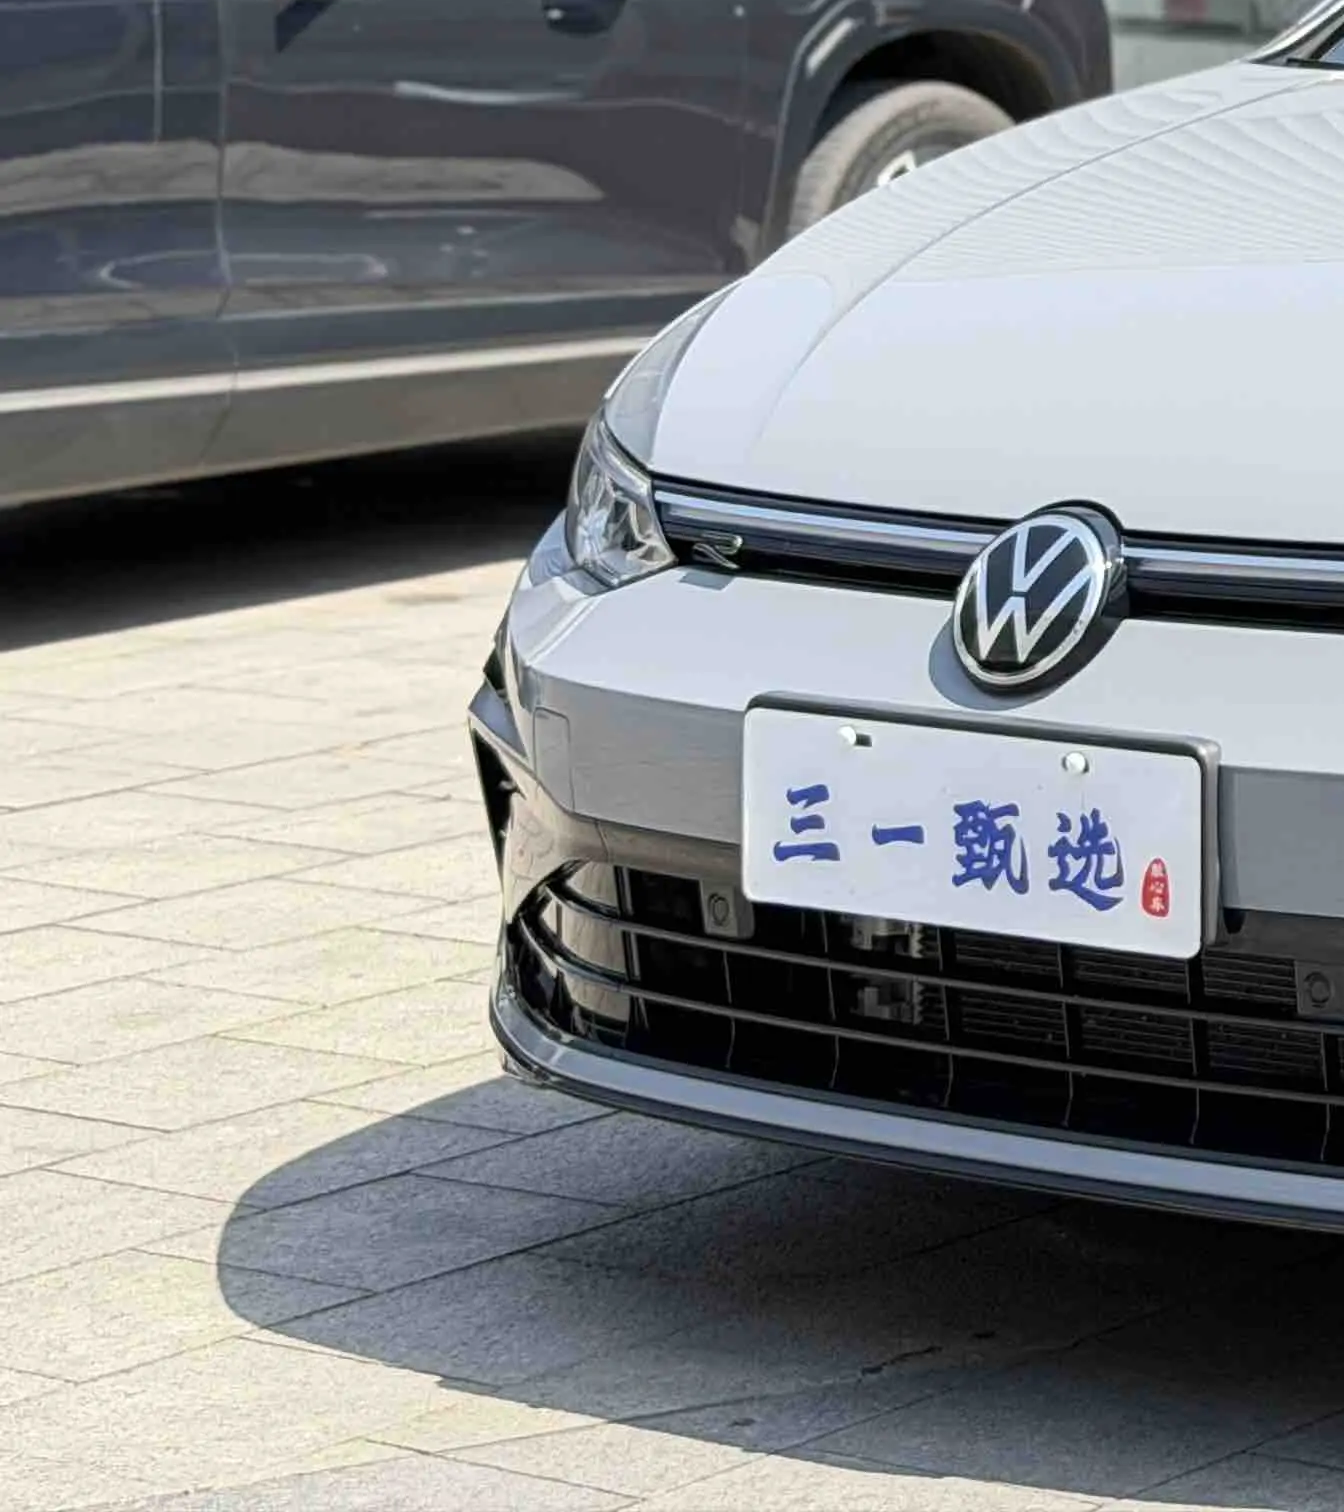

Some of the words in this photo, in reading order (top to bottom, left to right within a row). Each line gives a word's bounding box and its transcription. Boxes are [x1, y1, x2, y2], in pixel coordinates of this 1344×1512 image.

[954, 514, 1104, 684] VW
[773, 784, 1124, 911] 三一甄选
